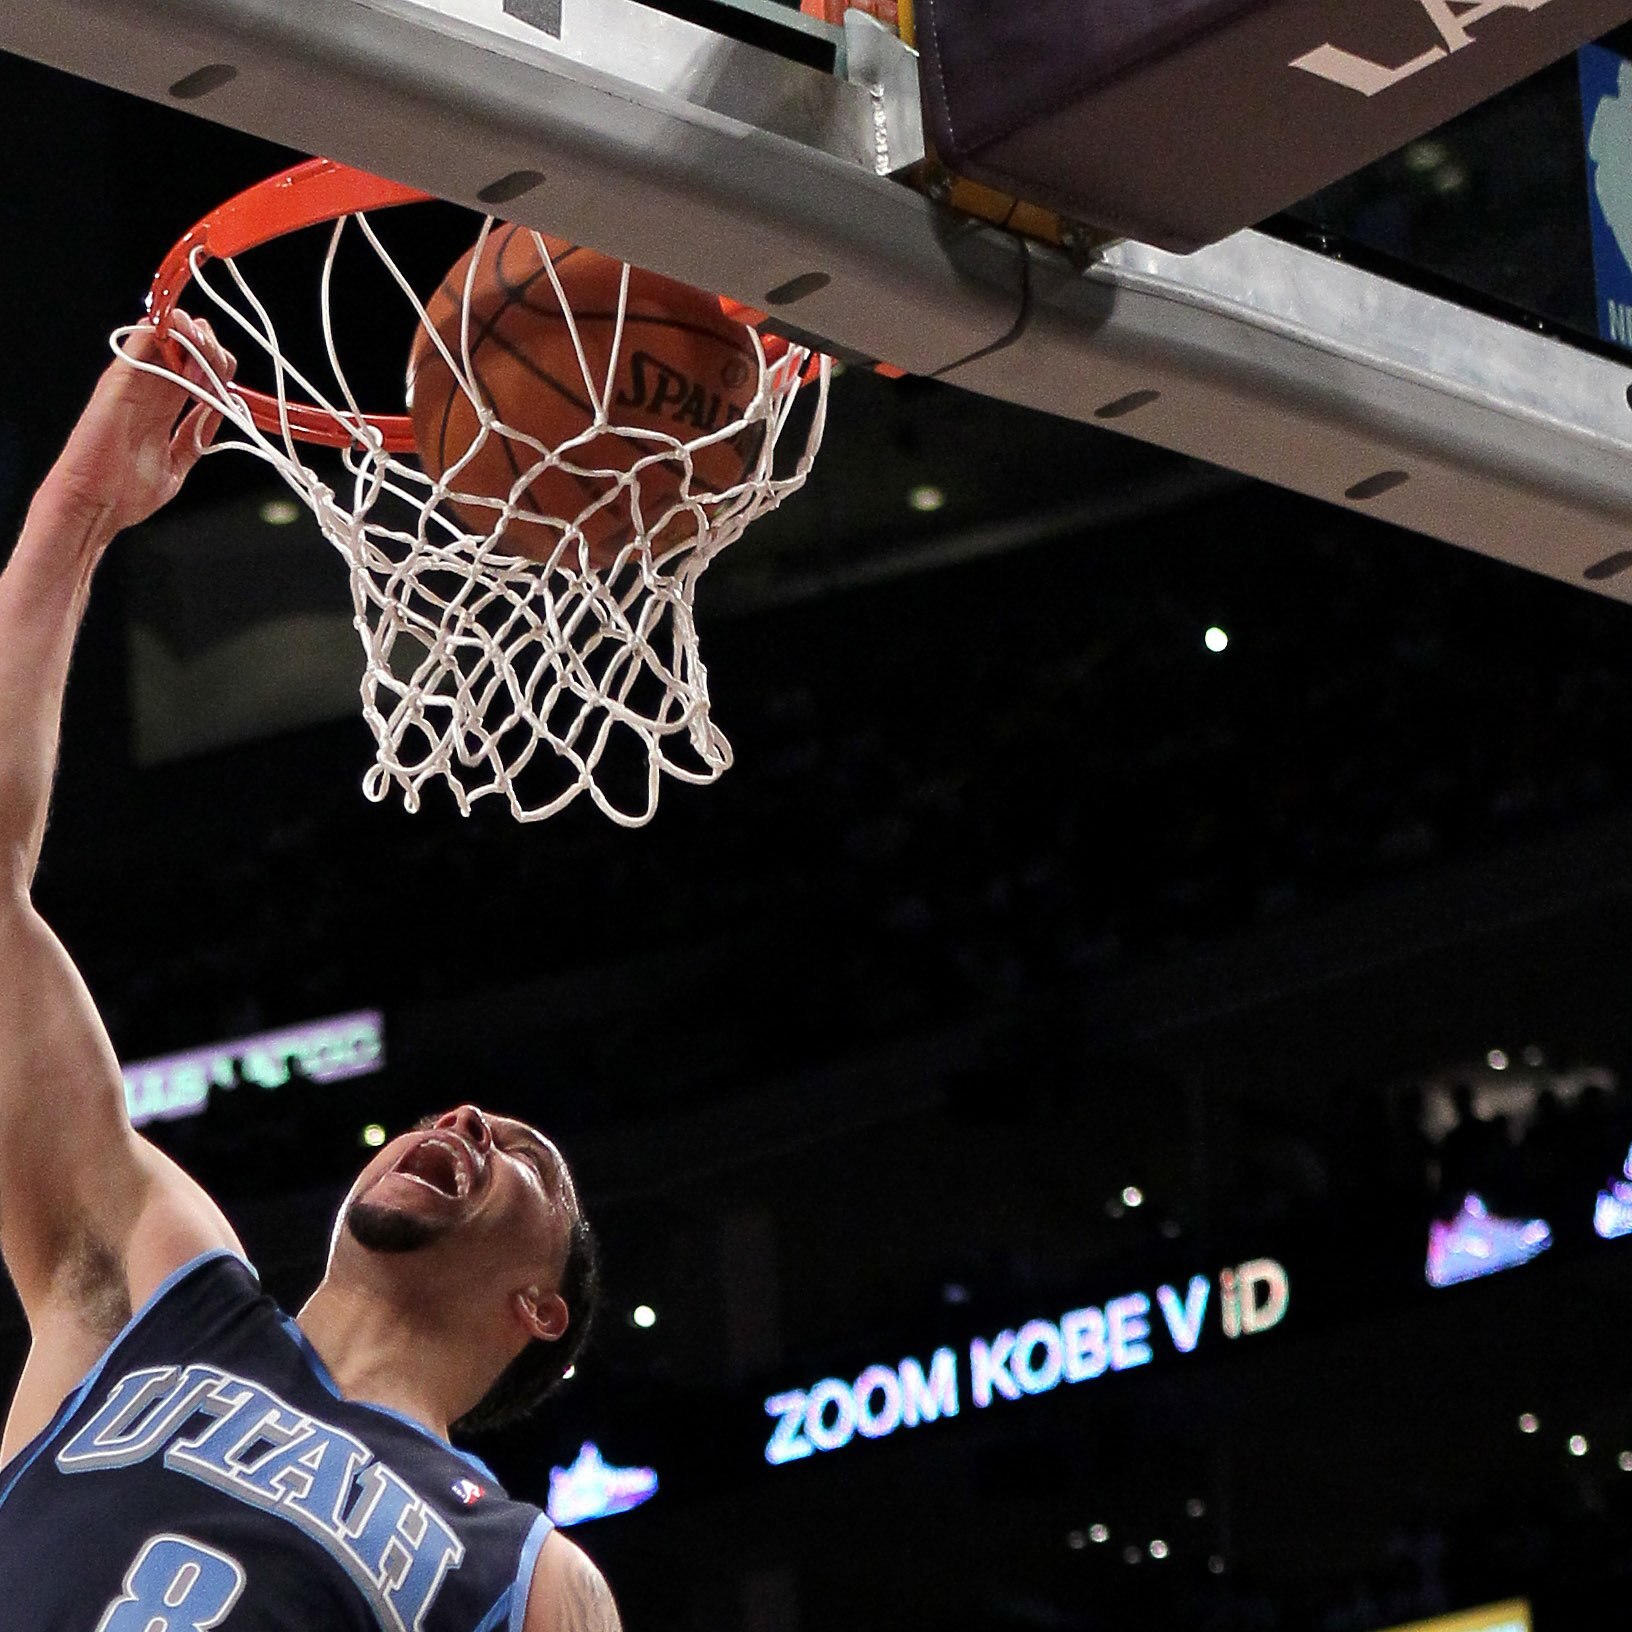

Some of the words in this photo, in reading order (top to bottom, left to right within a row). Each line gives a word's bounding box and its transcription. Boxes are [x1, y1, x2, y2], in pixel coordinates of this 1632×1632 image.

[765, 1347, 959, 1465] ZOOM
[970, 1293, 1153, 1408] KOBE
[1156, 1275, 1210, 1352] V
